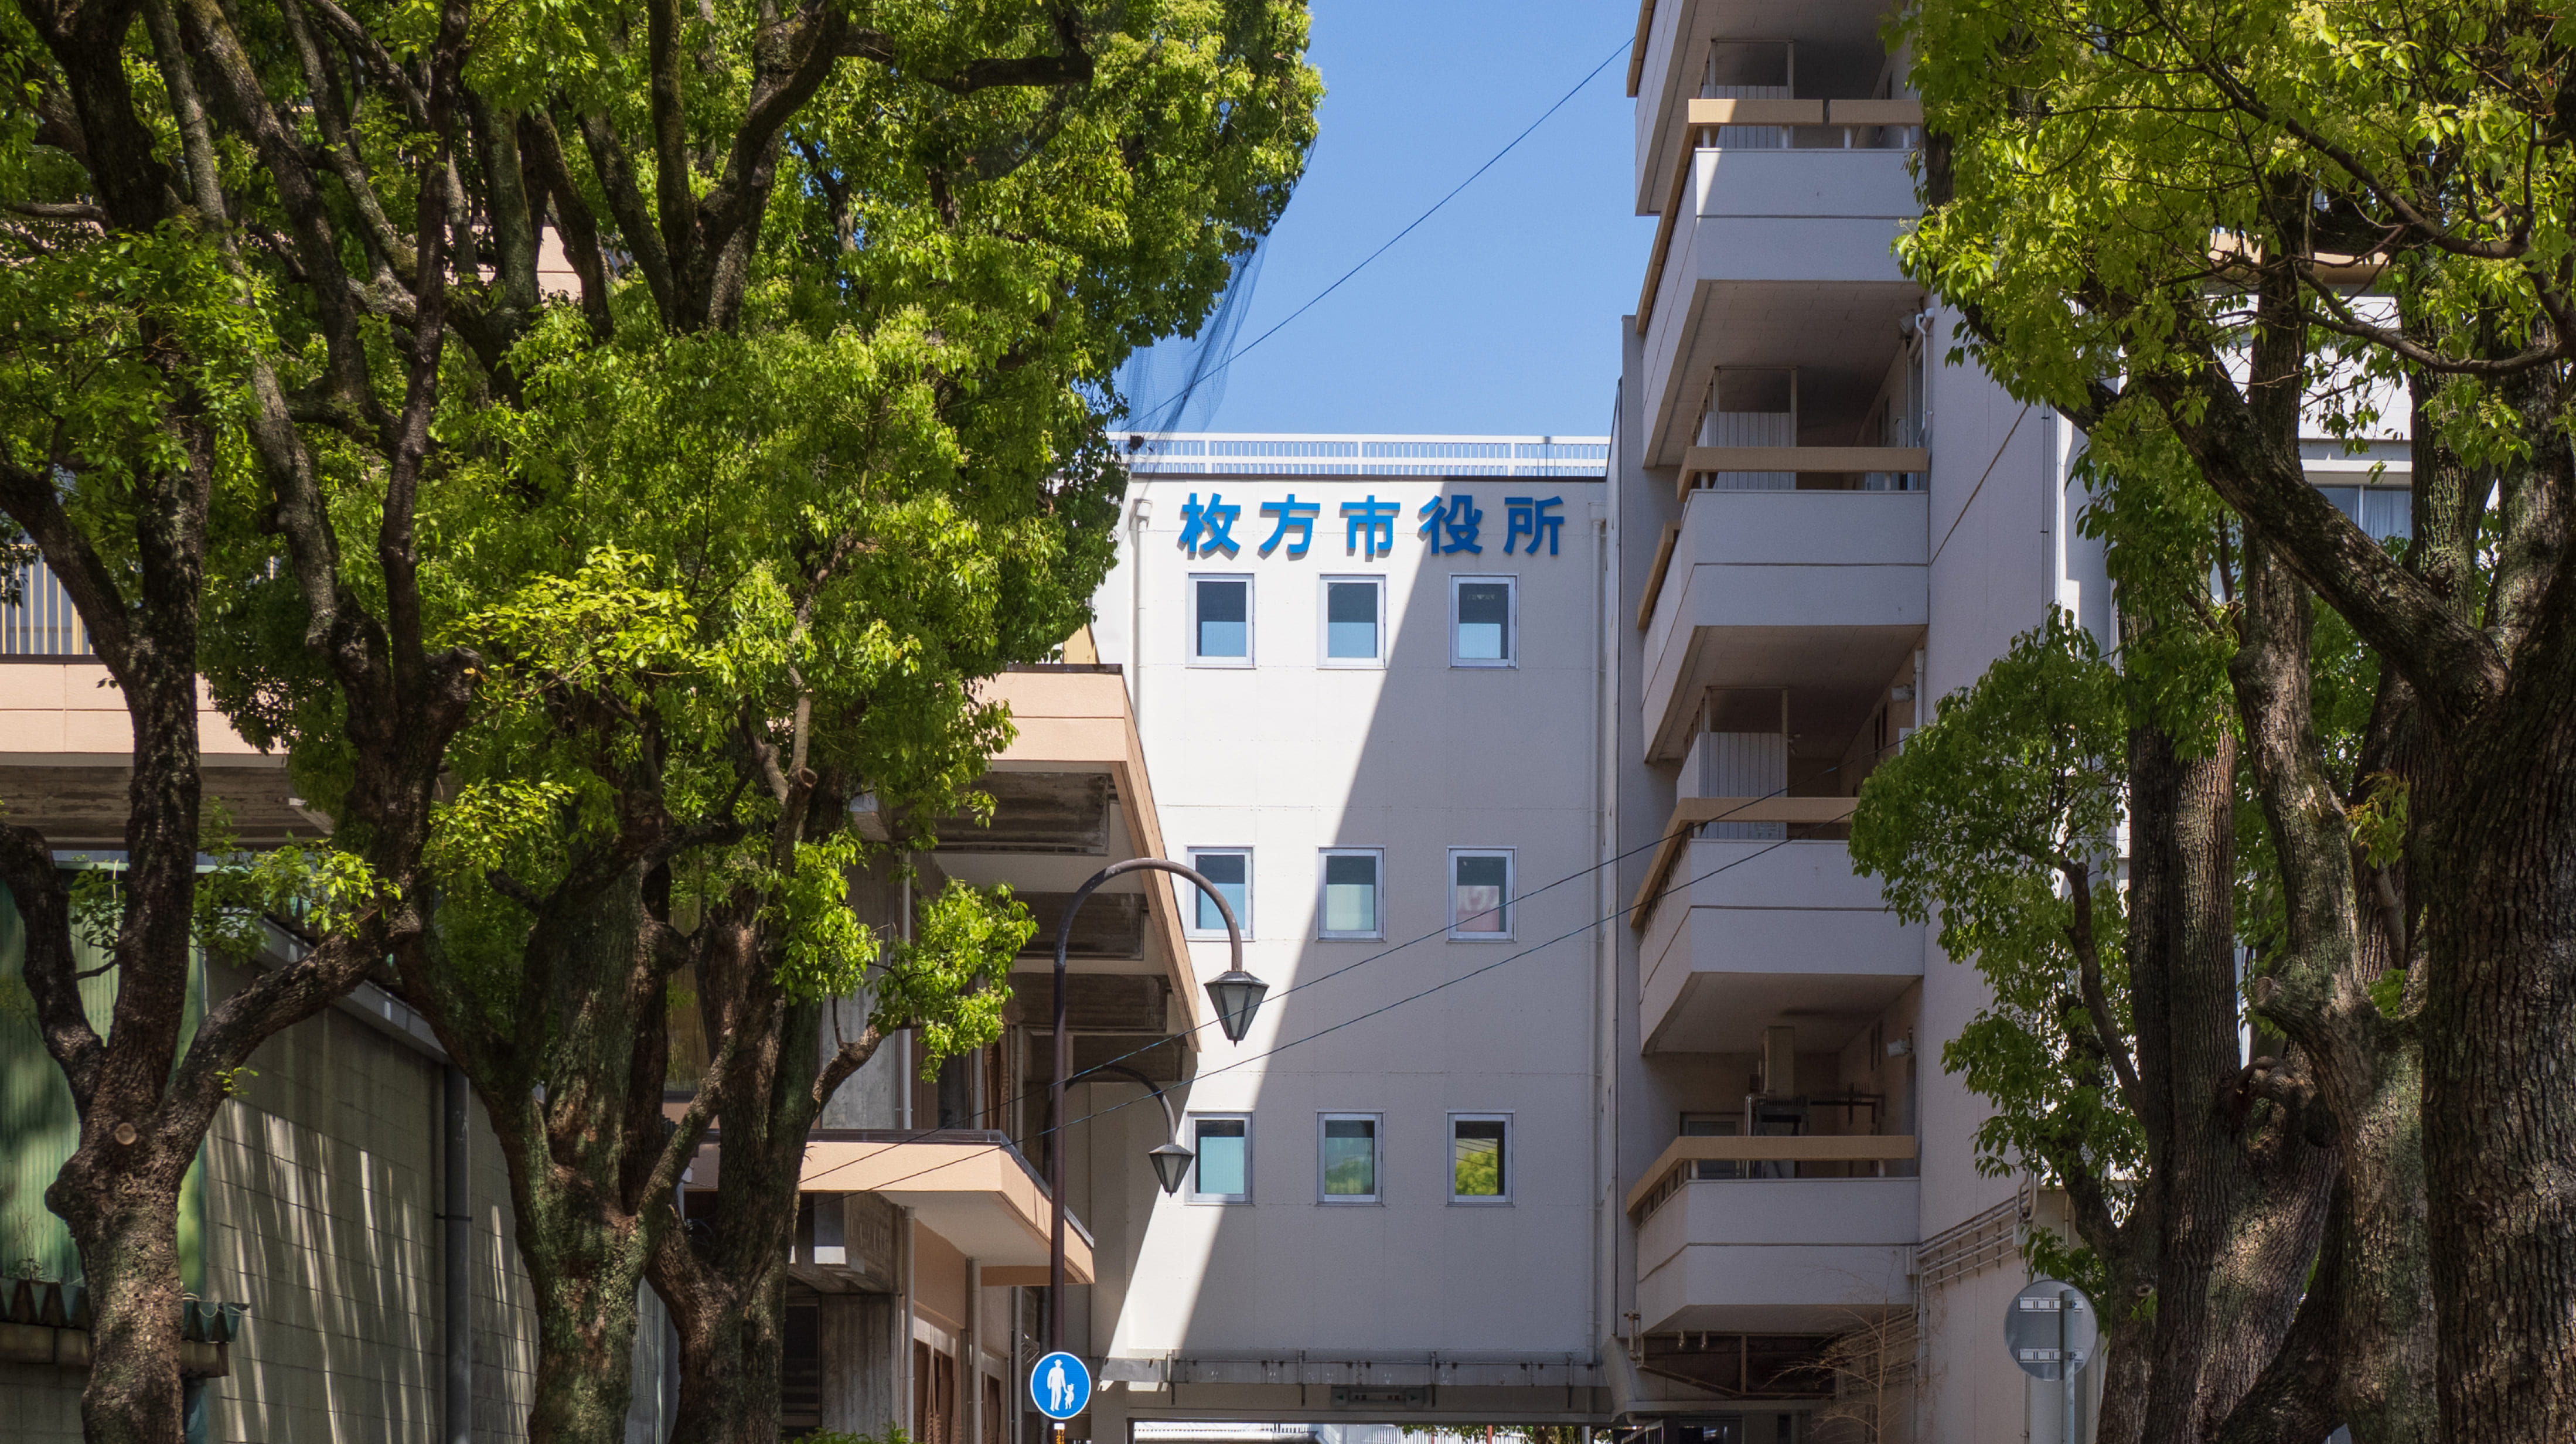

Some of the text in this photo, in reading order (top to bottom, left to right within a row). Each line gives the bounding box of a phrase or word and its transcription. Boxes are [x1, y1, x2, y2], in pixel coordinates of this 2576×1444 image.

[1179, 493, 1565, 555] 枚方市役所
